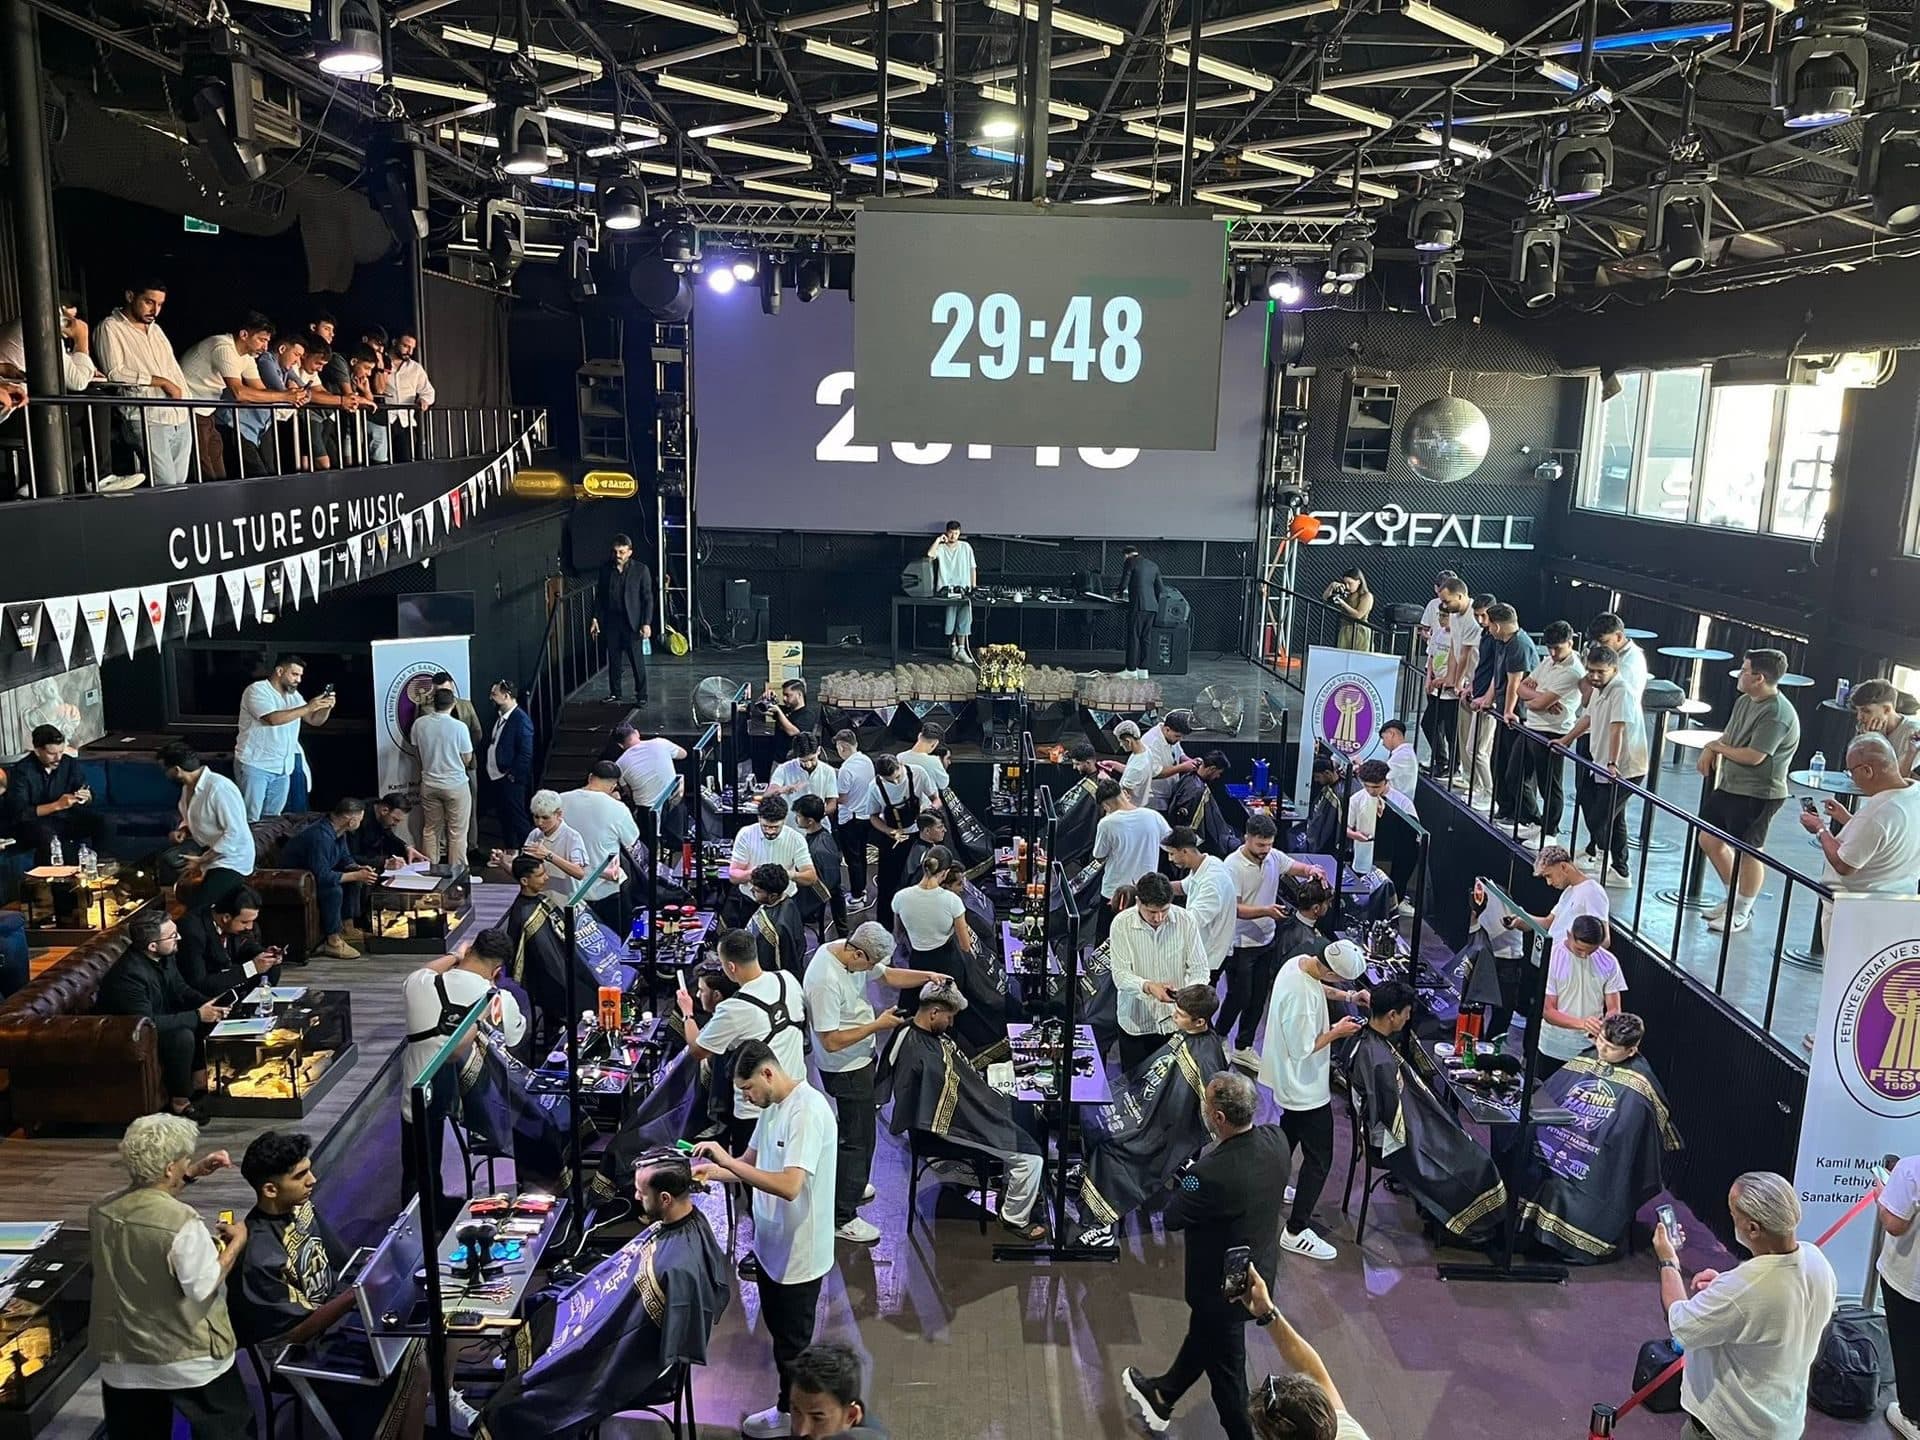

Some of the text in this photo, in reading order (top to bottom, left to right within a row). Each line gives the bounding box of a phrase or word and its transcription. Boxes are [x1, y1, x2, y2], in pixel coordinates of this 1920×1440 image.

[930, 291, 1143, 383] 29:48
[168, 492, 404, 570] CULTURE OF MUSIC
[1855, 956, 1887, 992] ESNAF
[1890, 946, 1908, 960] VE
[1883, 1081, 1917, 1091] 1969
[1816, 1157, 1850, 1169] Kamil
[1833, 1174, 1878, 1190] Fethiye
